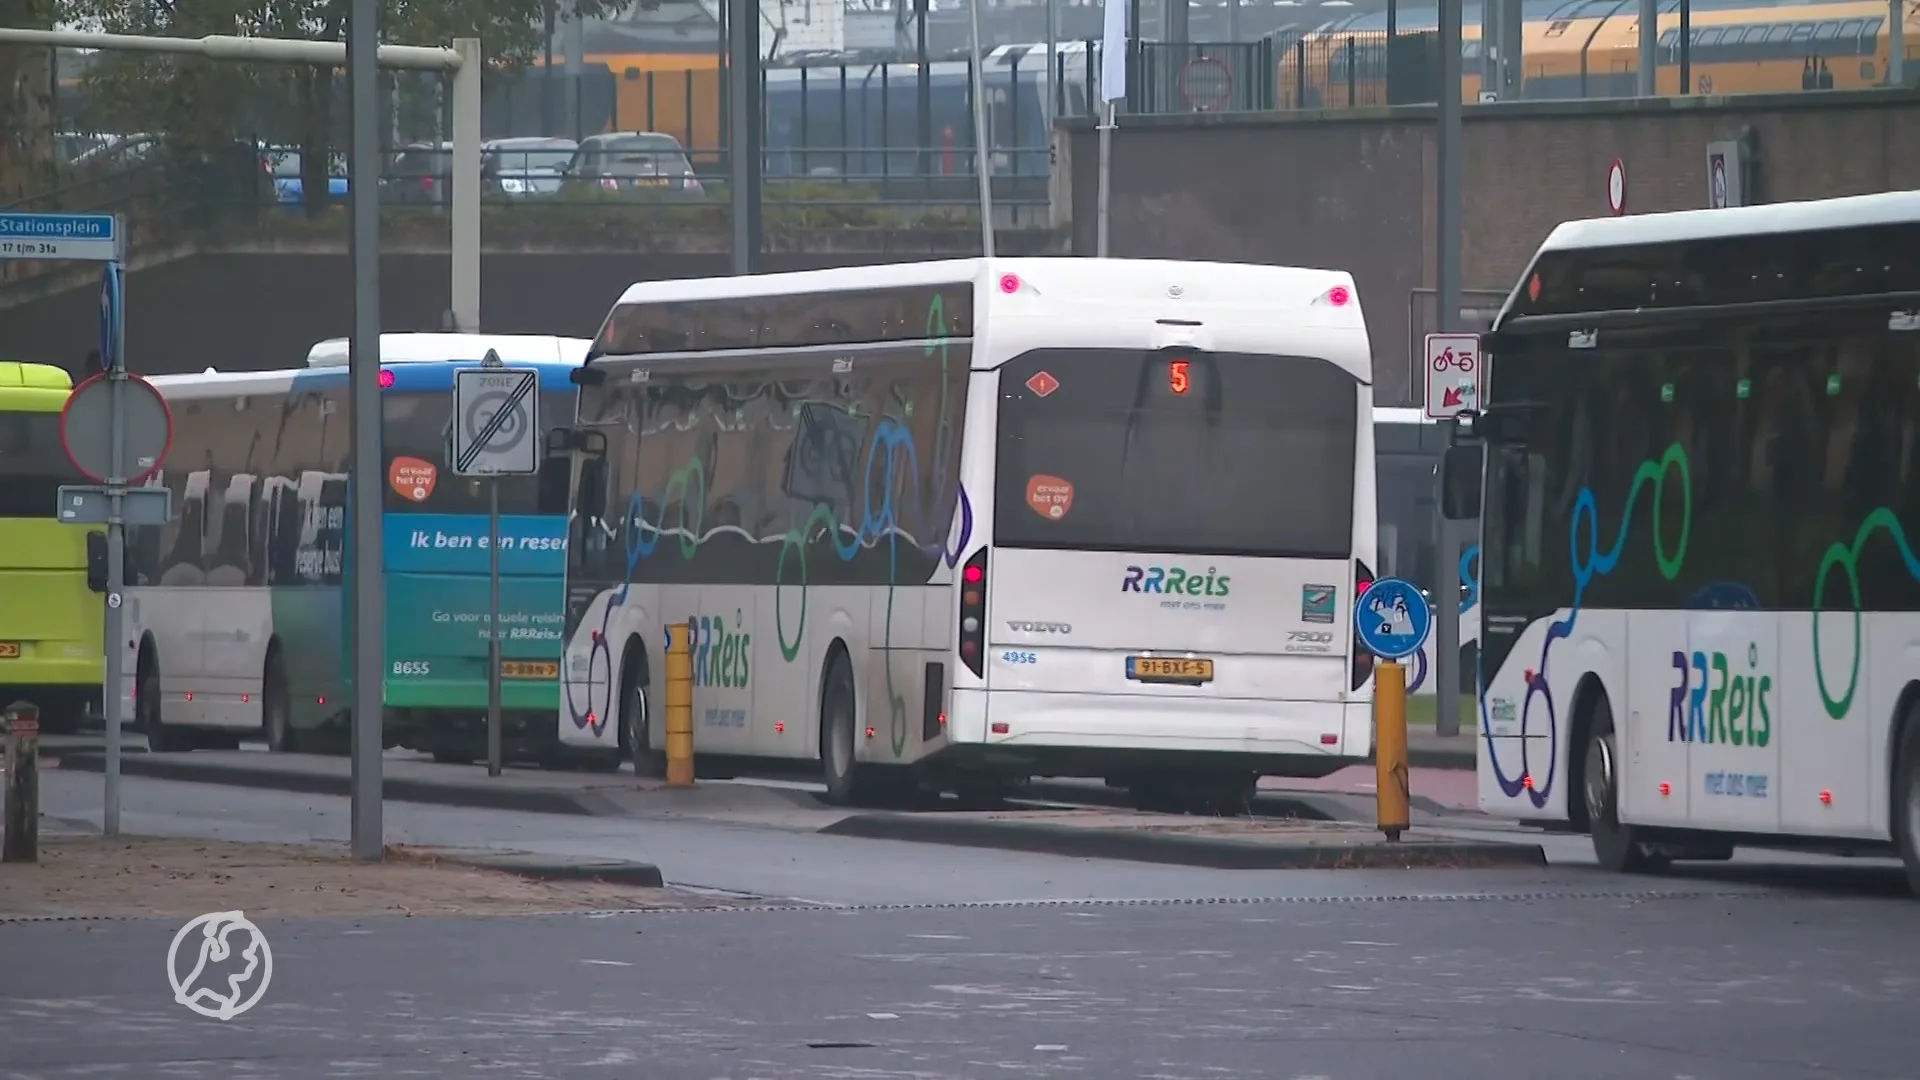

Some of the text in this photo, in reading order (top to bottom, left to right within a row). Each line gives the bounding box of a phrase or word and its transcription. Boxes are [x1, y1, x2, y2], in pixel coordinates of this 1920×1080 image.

[1, 219, 100, 235] Stationsplein
[2, 243, 57, 255] 17 t/m 31a
[479, 377, 513, 387] ZONE
[1170, 360, 1190, 393] 5
[411, 531, 429, 548] Ik
[434, 530, 471, 548] ben
[477, 535, 513, 549] en
[1121, 566, 1230, 597] RRReis
[432, 611, 450, 622] Go
[453, 613, 480, 622] voor
[484, 611, 528, 624] atuele
[1006, 621, 1073, 634] VOLVO
[1286, 631, 1334, 644] 7900
[1002, 651, 1037, 665] 4956
[393, 661, 430, 675] 8655
[1141, 659, 1205, 675] 91-BXF-5
[1668, 641, 1772, 748] RRReis
